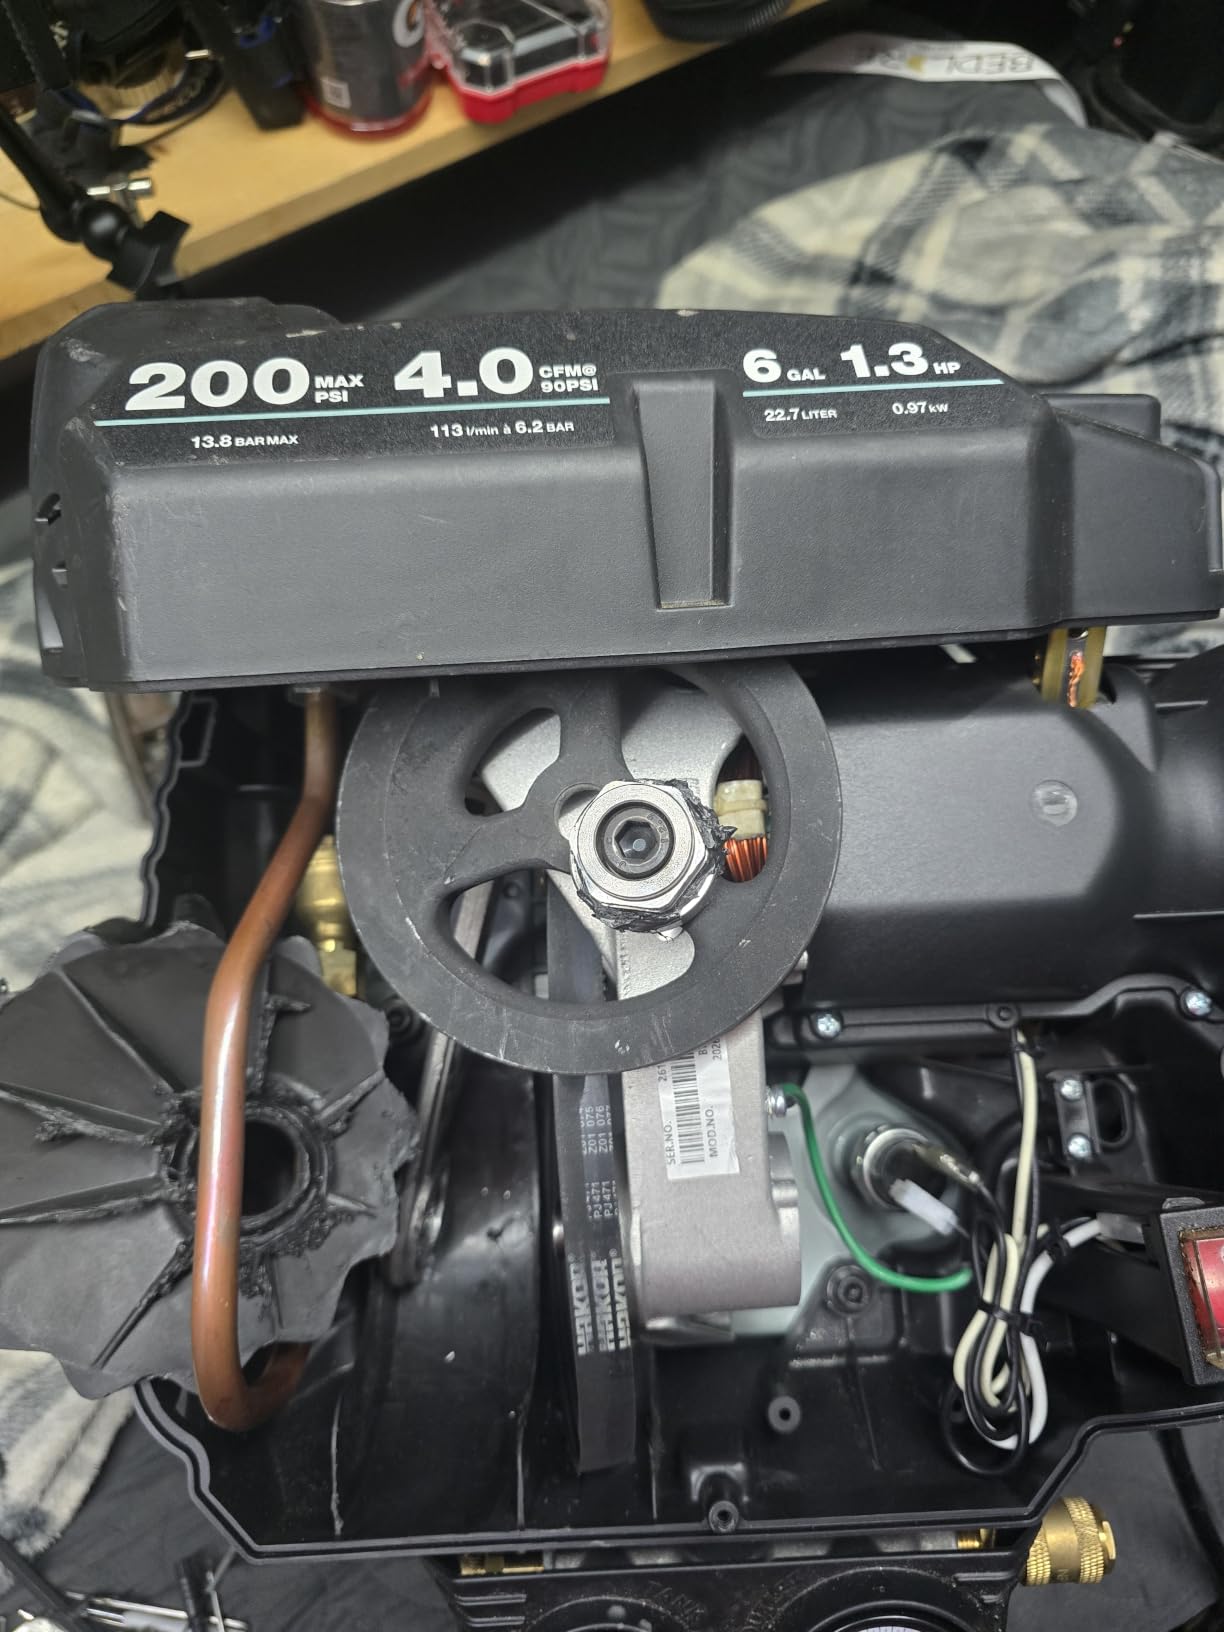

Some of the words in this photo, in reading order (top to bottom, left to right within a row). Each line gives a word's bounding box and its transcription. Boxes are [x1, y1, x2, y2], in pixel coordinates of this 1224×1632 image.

[743, 348, 782, 383] 6
[786, 367, 826, 381] GAL
[840, 342, 929, 378] 1.3
[933, 362, 961, 375] HP
[394, 347, 534, 398] 4.0
[538, 364, 597, 379] CFM@
[125, 357, 310, 411] 200
[314, 374, 364, 389] MAX
[540, 378, 599, 393] 90PSI
[315, 389, 349, 403] PSI
[764, 408, 800, 422] 22.7
[801, 409, 838, 420] LITER
[892, 401, 927, 415] 0.97
[430, 422, 463, 438] 113
[515, 420, 544, 434] 6.2
[546, 421, 574, 433] BAR
[191, 434, 233, 449] 13.8
[234, 436, 265, 448] BAR
[266, 434, 299, 446] MAX
[705, 1104, 719, 1158] MOD.NO.
[664, 1119, 676, 1166] SER.NO.
